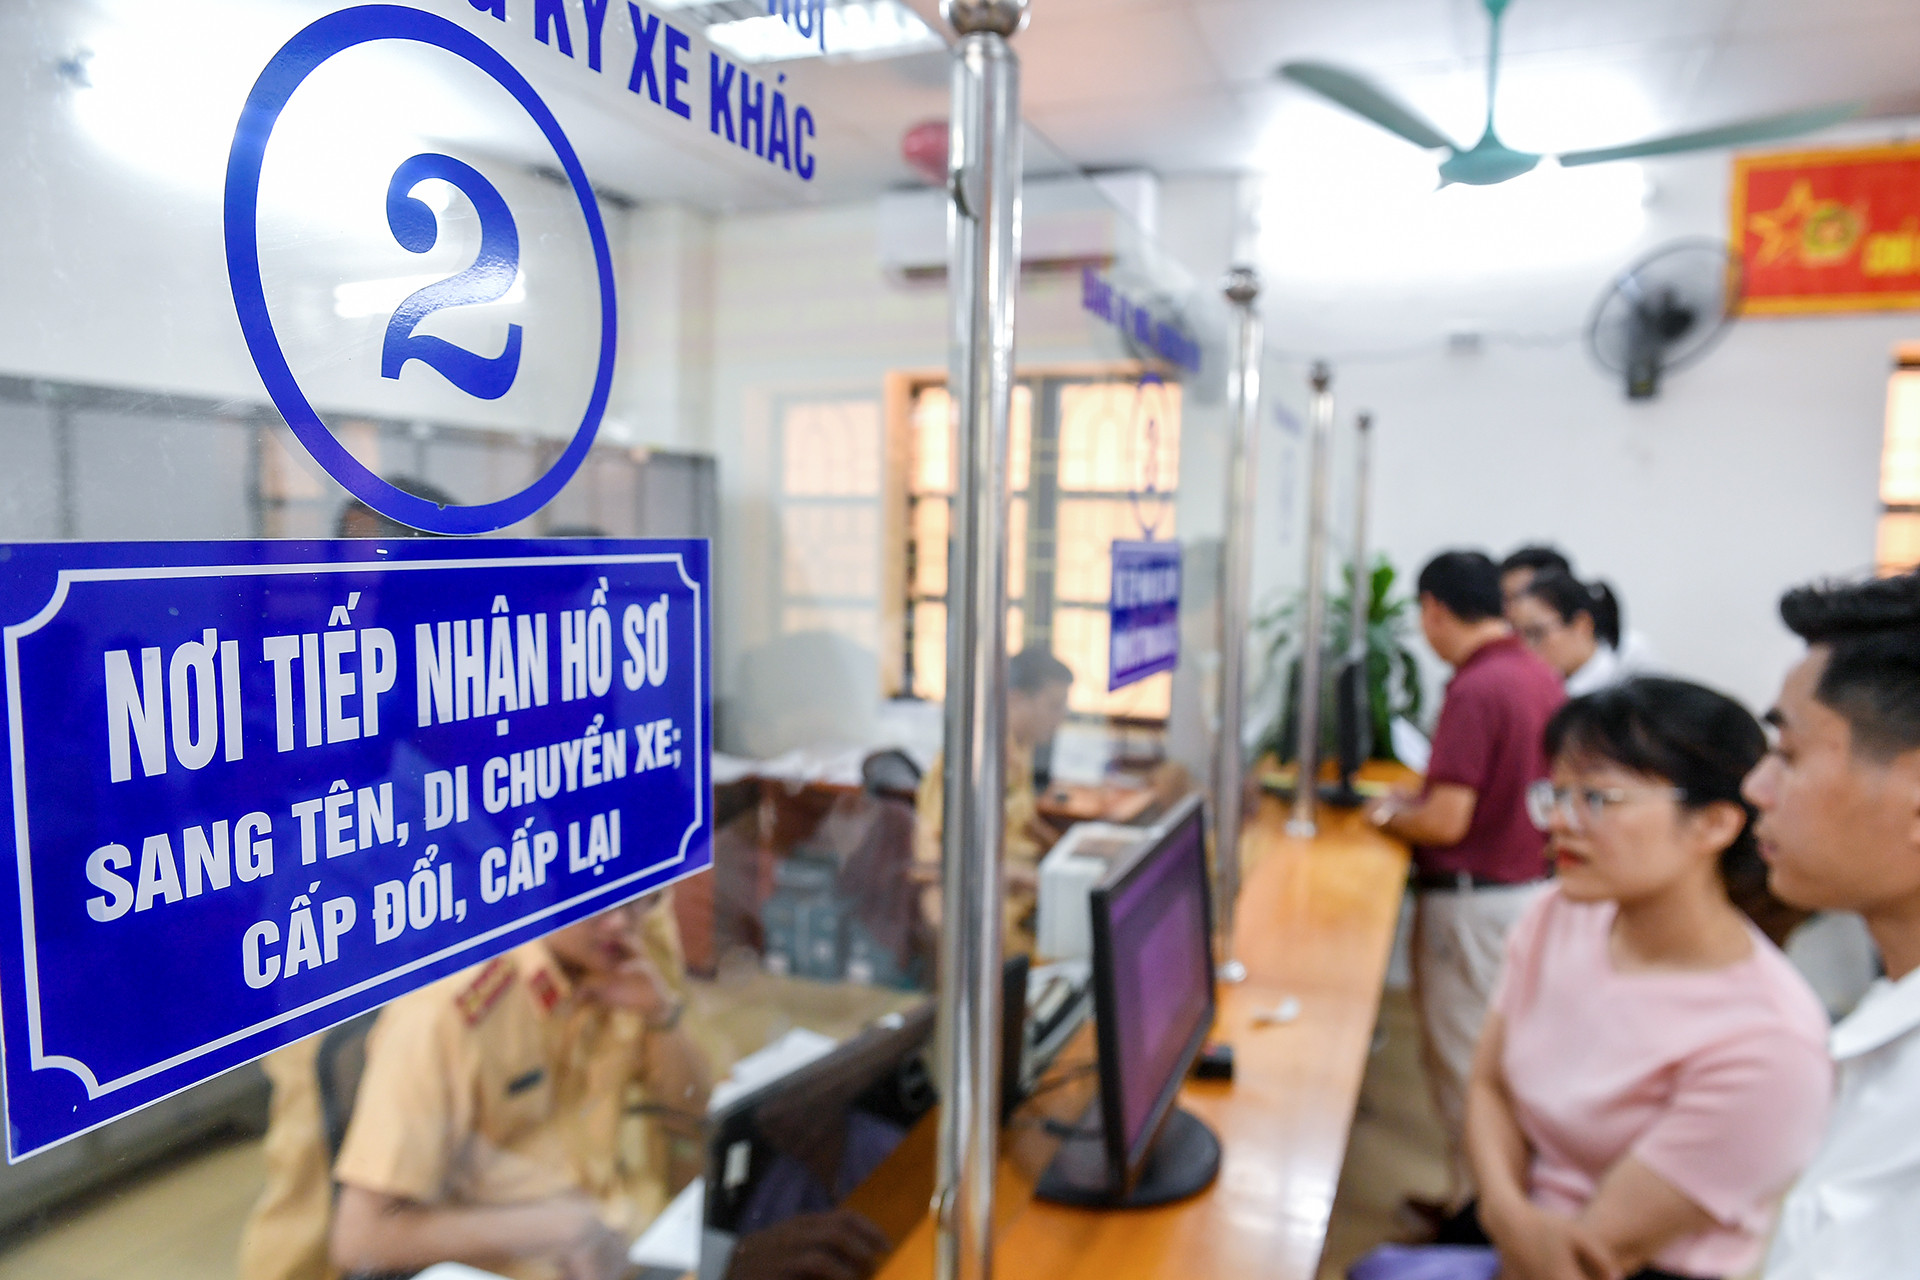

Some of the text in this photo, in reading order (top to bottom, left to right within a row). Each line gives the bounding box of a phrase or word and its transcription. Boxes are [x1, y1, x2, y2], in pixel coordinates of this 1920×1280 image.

[628, 1, 691, 120] XE
[709, 52, 817, 183] KHÁC
[382, 152, 521, 401] 2
[104, 576, 669, 784] NƠI TIẾP NHẬN HỒ SƠ
[86, 713, 682, 923] SANG TÊN, DI CHUYỂN XE;
[242, 809, 621, 989] CẤP ĐỔI, CẤP LẠI
